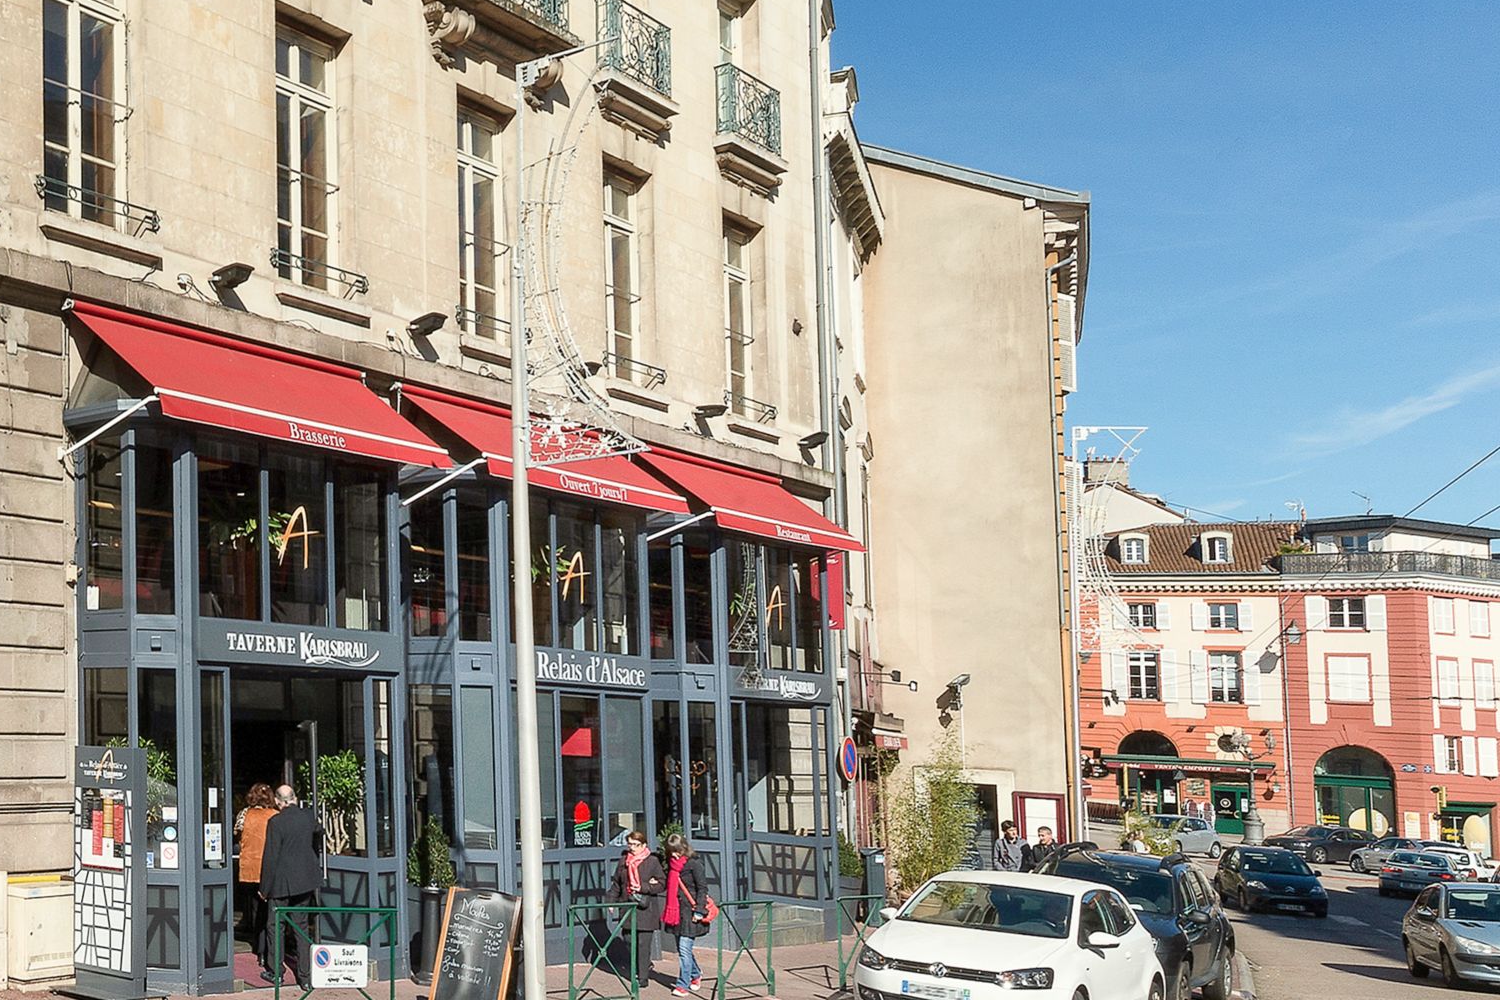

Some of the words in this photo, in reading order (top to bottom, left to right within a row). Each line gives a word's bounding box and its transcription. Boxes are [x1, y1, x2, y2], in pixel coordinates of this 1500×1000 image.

[288, 422, 347, 448] Brasserie
[560, 474, 591, 494] Ouvert
[226, 632, 296, 655] TAVERNE
[536, 651, 582, 682] Relais
[585, 656, 646, 686] d'Alsace
[341, 948, 355, 957] Sauf
